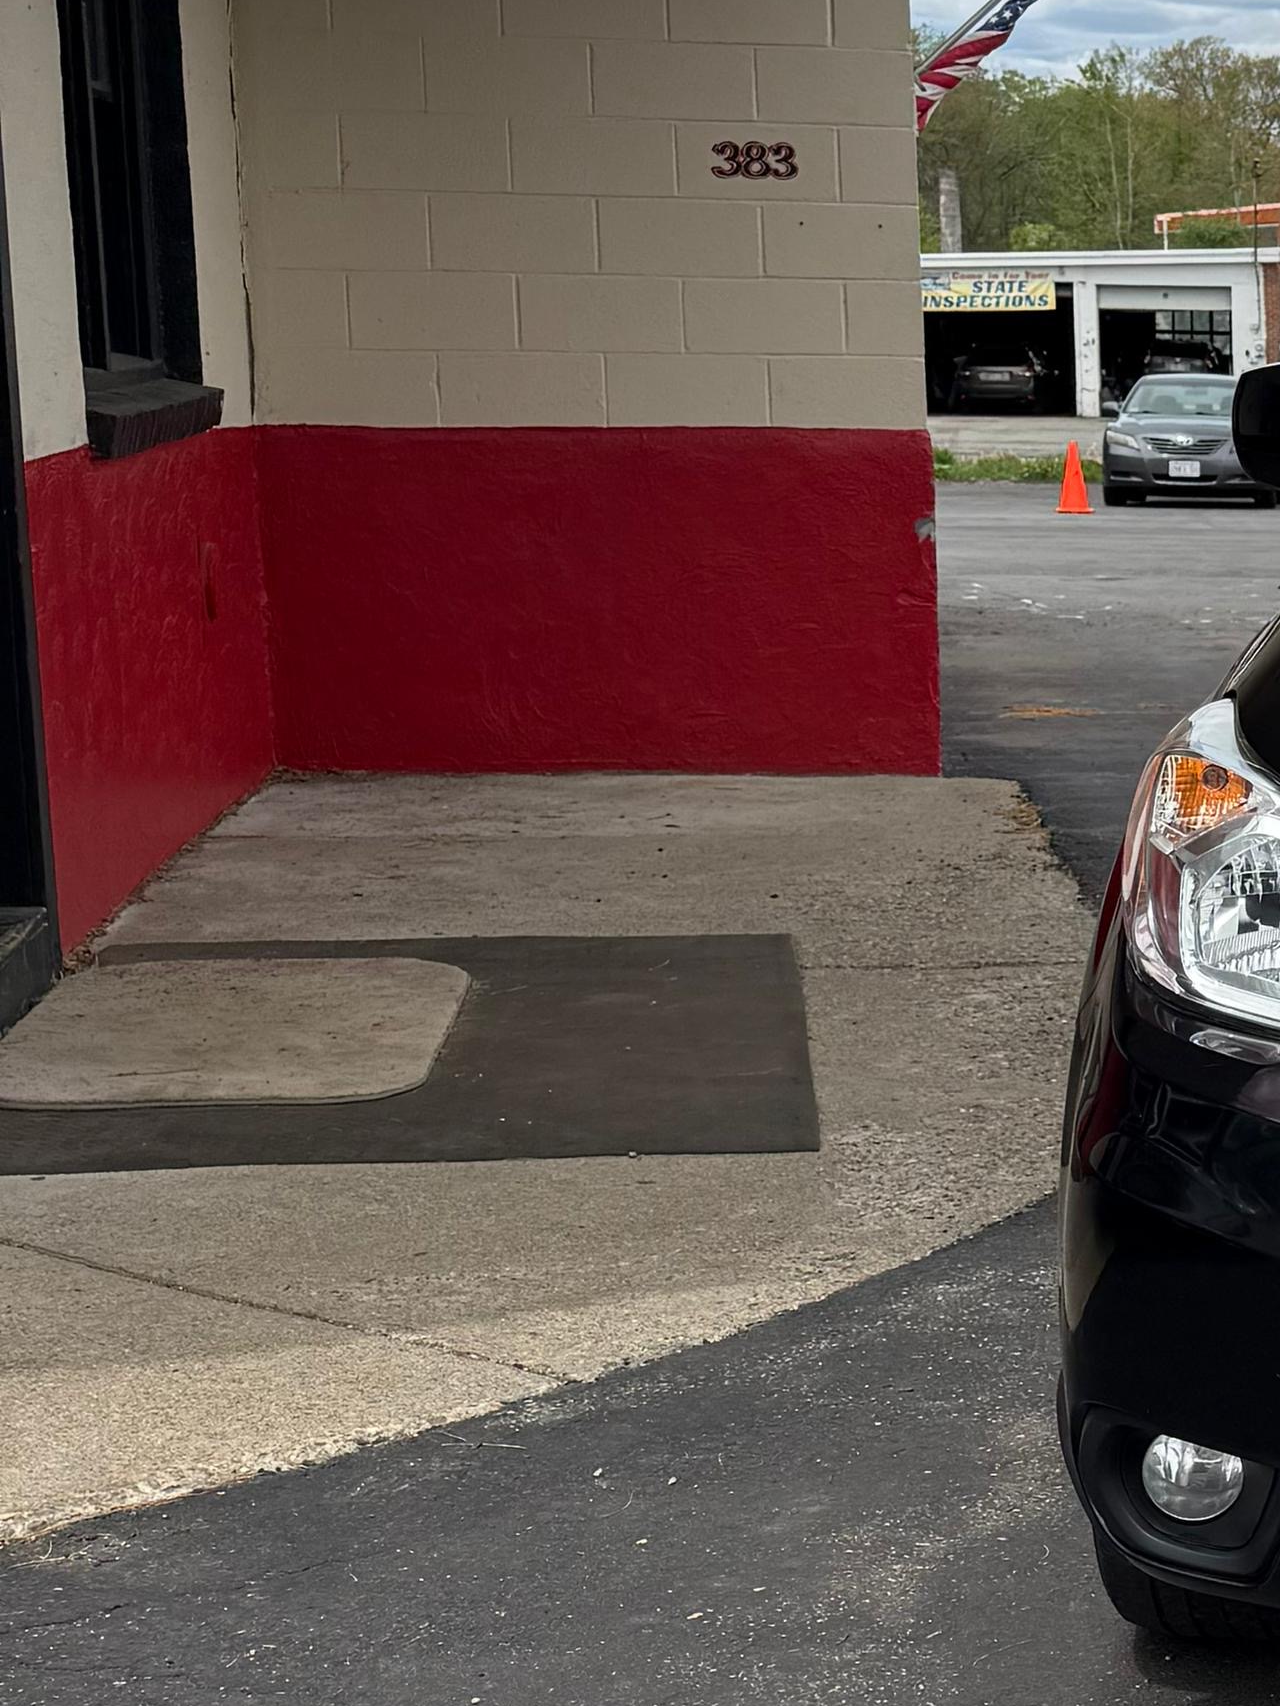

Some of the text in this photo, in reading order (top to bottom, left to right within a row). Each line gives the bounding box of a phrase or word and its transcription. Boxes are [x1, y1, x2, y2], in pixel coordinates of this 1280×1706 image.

[711, 144, 799, 181] 383
[972, 280, 1028, 293] STATE
[923, 294, 1049, 308] INSPECTIONS
